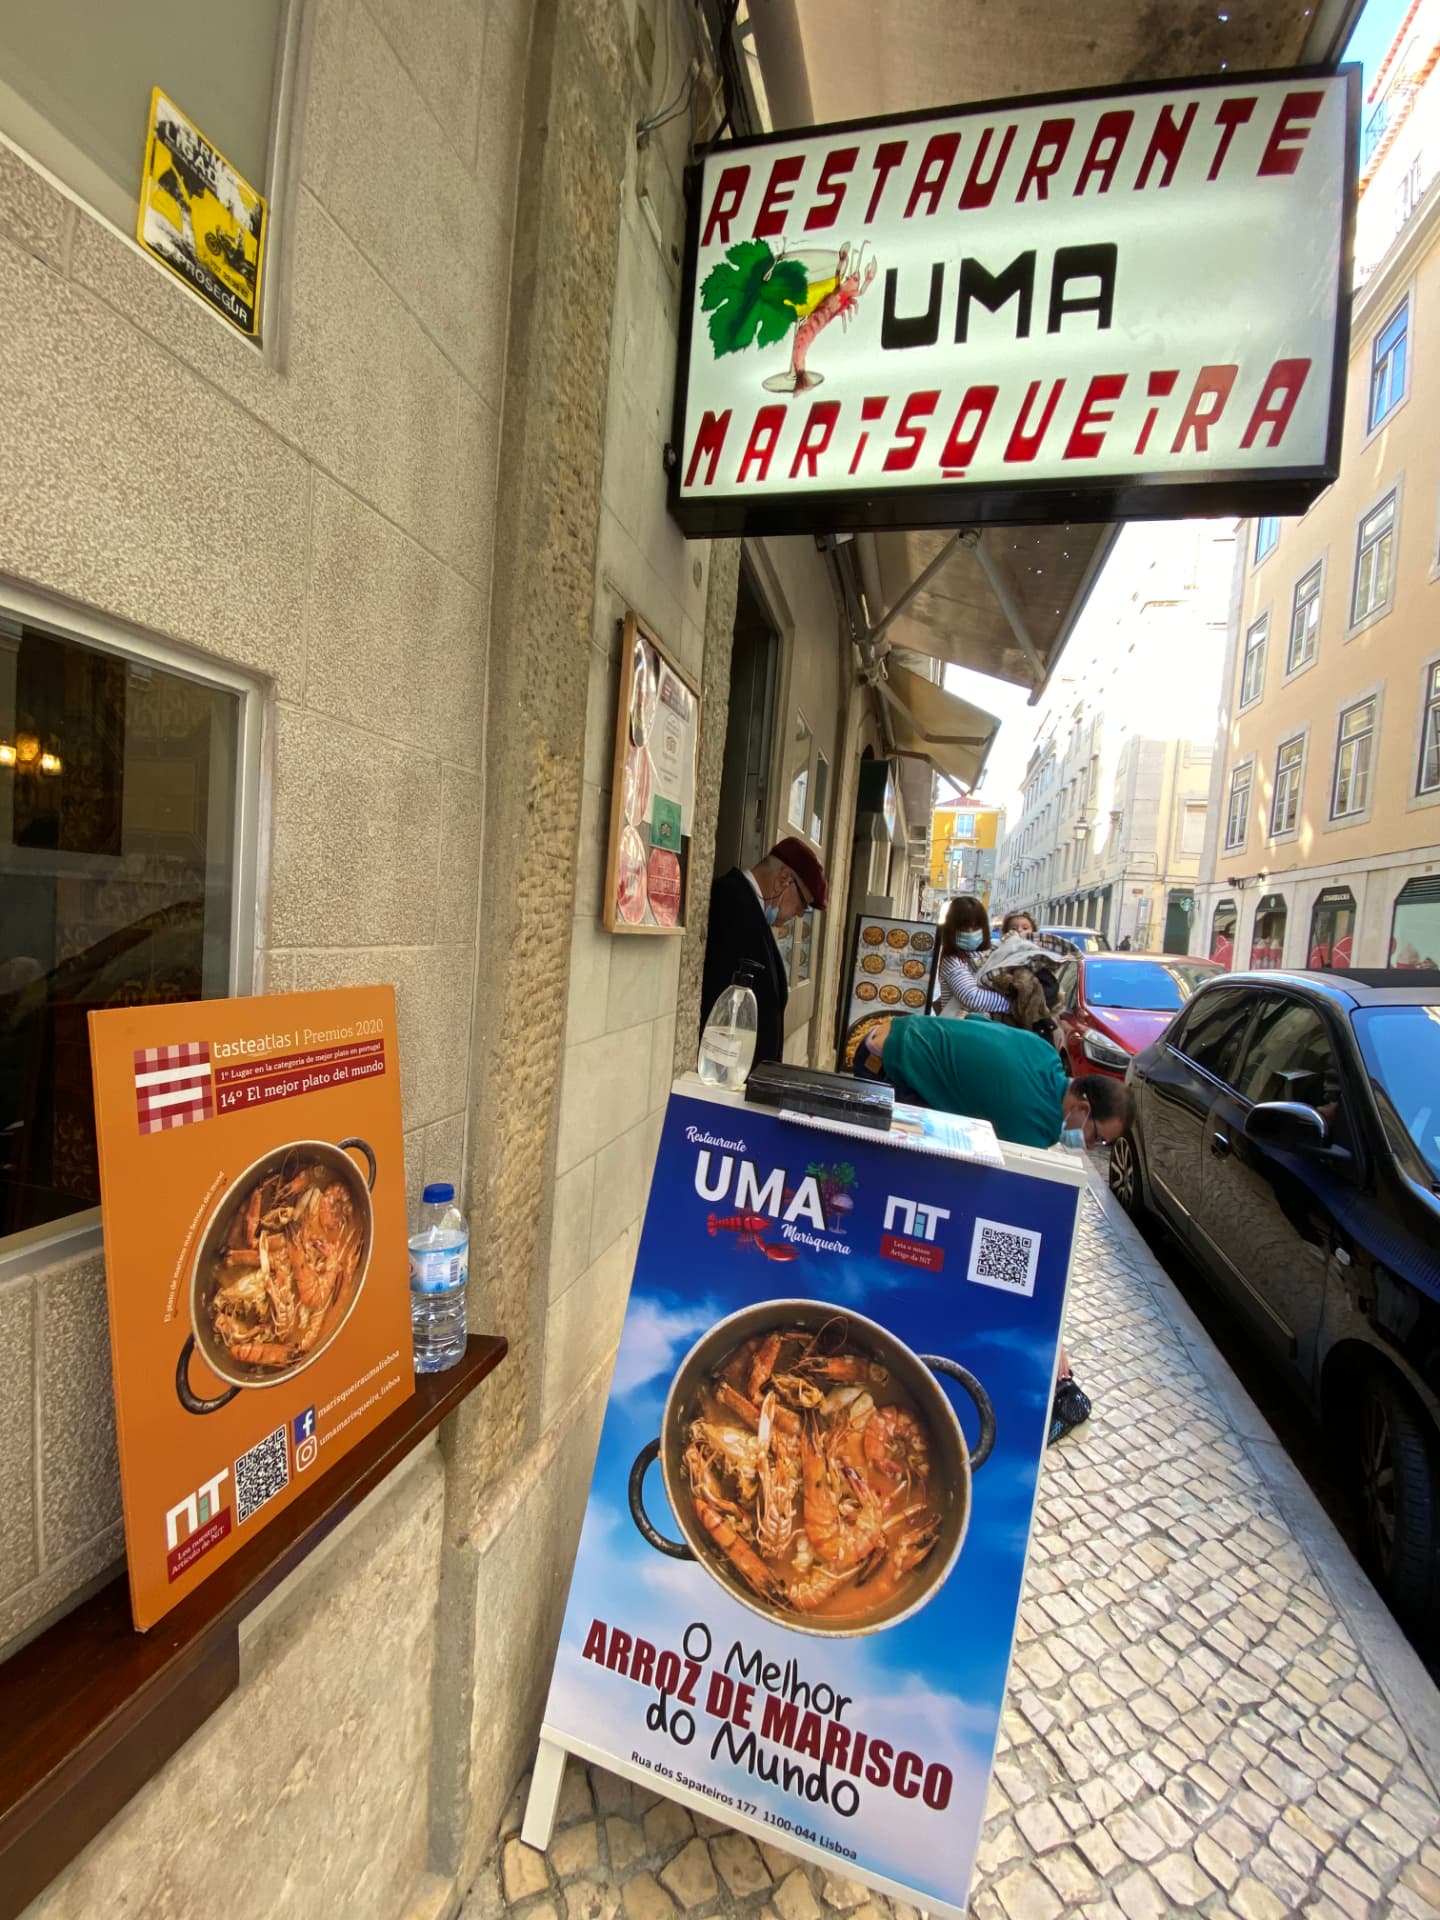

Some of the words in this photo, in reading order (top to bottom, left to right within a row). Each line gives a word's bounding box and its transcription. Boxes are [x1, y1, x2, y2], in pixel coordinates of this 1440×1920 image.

[701, 91, 1324, 246] RESTAURANTE
[174, 250, 249, 324] PROSEGUR
[881, 242, 1117, 349] UMA
[213, 1032, 291, 1059] tasteatlas
[303, 1026, 353, 1045] Premios
[356, 1018, 384, 1036] 2020
[231, 1067, 253, 1080] Lugar
[255, 1065, 264, 1074] en
[265, 1062, 273, 1071] la
[306, 1056, 314, 1065] de
[247, 1086, 260, 1101] El
[265, 1079, 299, 1097] mejor
[302, 1073, 330, 1091] plato
[333, 1067, 349, 1082] del
[352, 1061, 384, 1076] mundo
[686, 1126, 746, 1152] Restaurante
[694, 1150, 825, 1231] UMA
[781, 1223, 850, 1256] Marisqueira
[683, 1622, 712, 1662] O
[723, 1641, 852, 1721] Melhor
[581, 1619, 702, 1706] ARROZ
[704, 1671, 756, 1730] DE
[760, 1696, 953, 1811] MARISCO
[646, 1687, 695, 1745] do
[711, 1722, 860, 1816] Mundo
[631, 1750, 652, 1769] Rua
[654, 1761, 673, 1779] dos
[676, 1770, 733, 1806] Sapateiros
[736, 1798, 757, 1815] 177
[763, 1810, 817, 1843] 1100-044
[819, 1835, 857, 1860] Lisboa
